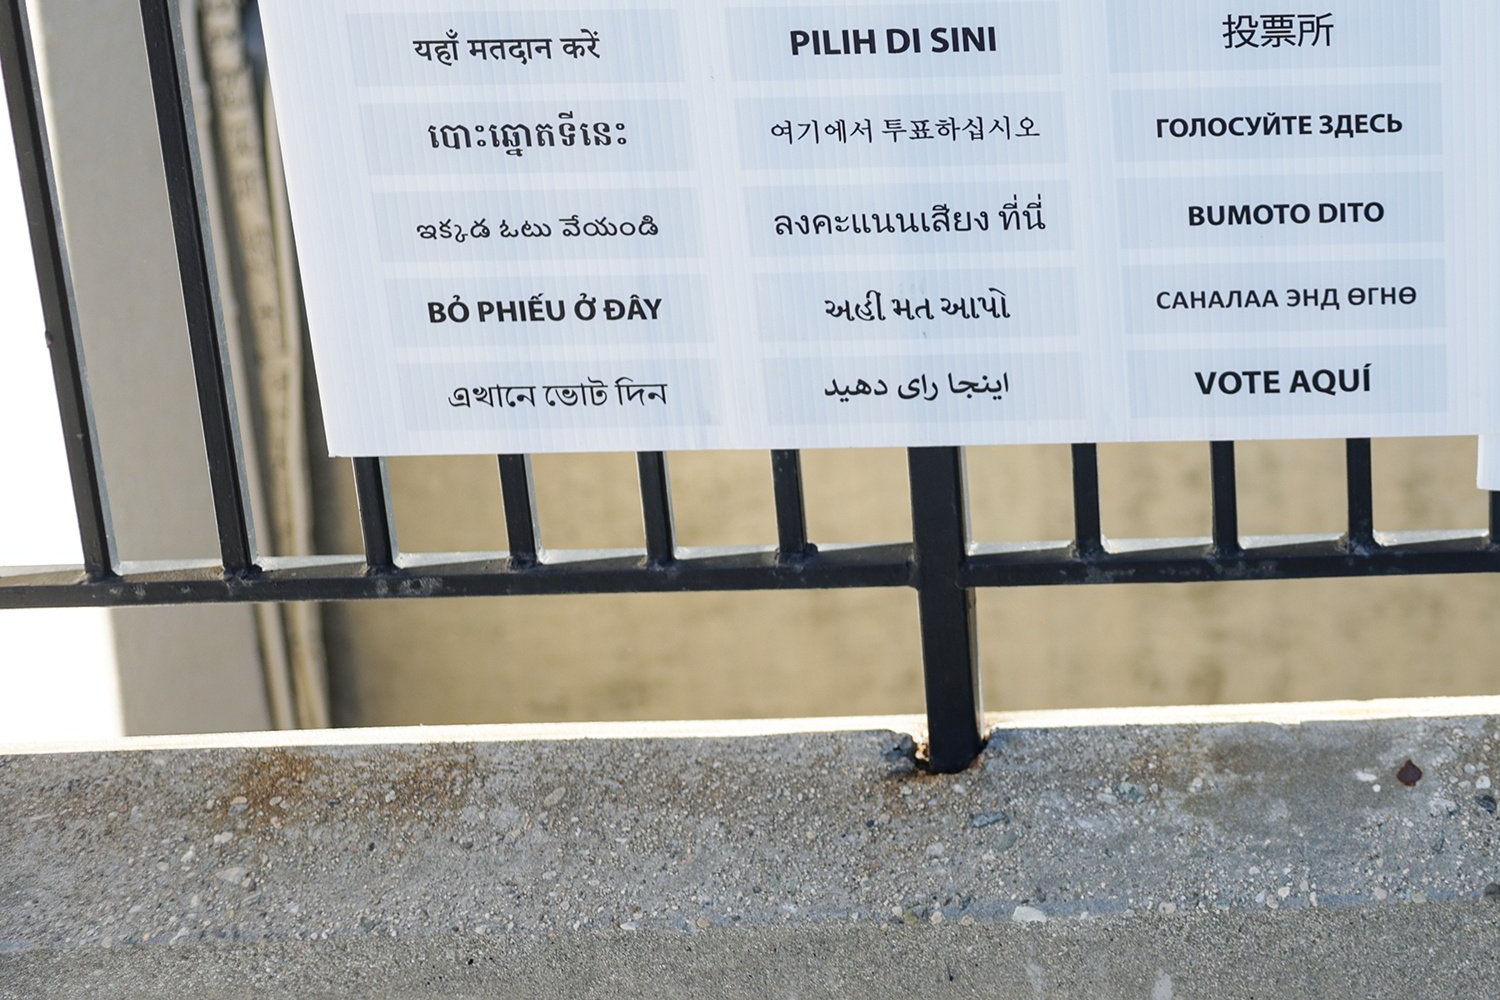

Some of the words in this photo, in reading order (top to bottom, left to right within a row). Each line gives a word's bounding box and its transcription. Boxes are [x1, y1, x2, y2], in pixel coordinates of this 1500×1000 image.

[790, 29, 876, 55] PILIH
[886, 28, 921, 54] DI
[931, 27, 996, 53] SINI
[1222, 13, 1334, 49] 投票所
[413, 29, 459, 66] यहाँ
[467, 39, 552, 65] मतदान
[559, 29, 600, 59] करें
[771, 119, 872, 144] 여기에서
[882, 116, 1040, 143] 투표하십시오
[1157, 112, 1312, 138] ГОЛОСУЙТЕ
[1319, 114, 1402, 138] ЗДЕСЬ
[774, 204, 989, 235] ลงคะแนนเสียง
[998, 194, 1046, 230] ที่นี่
[1189, 204, 1310, 226] BUMOTO
[1319, 202, 1384, 223] DITO
[428, 295, 469, 323] BỎ
[477, 293, 565, 322] PHIẾU
[603, 294, 662, 320] ĐÂY
[1157, 290, 1279, 309] САНАЛАА
[1287, 288, 1340, 310] ЭНД
[1348, 287, 1416, 305] ӨГНӨ
[448, 384, 536, 408] এখানে
[542, 377, 608, 406] ভোট
[614, 377, 668, 406] দিন
[1195, 371, 1280, 394] VOTE
[1289, 363, 1371, 396] AQUÍ
